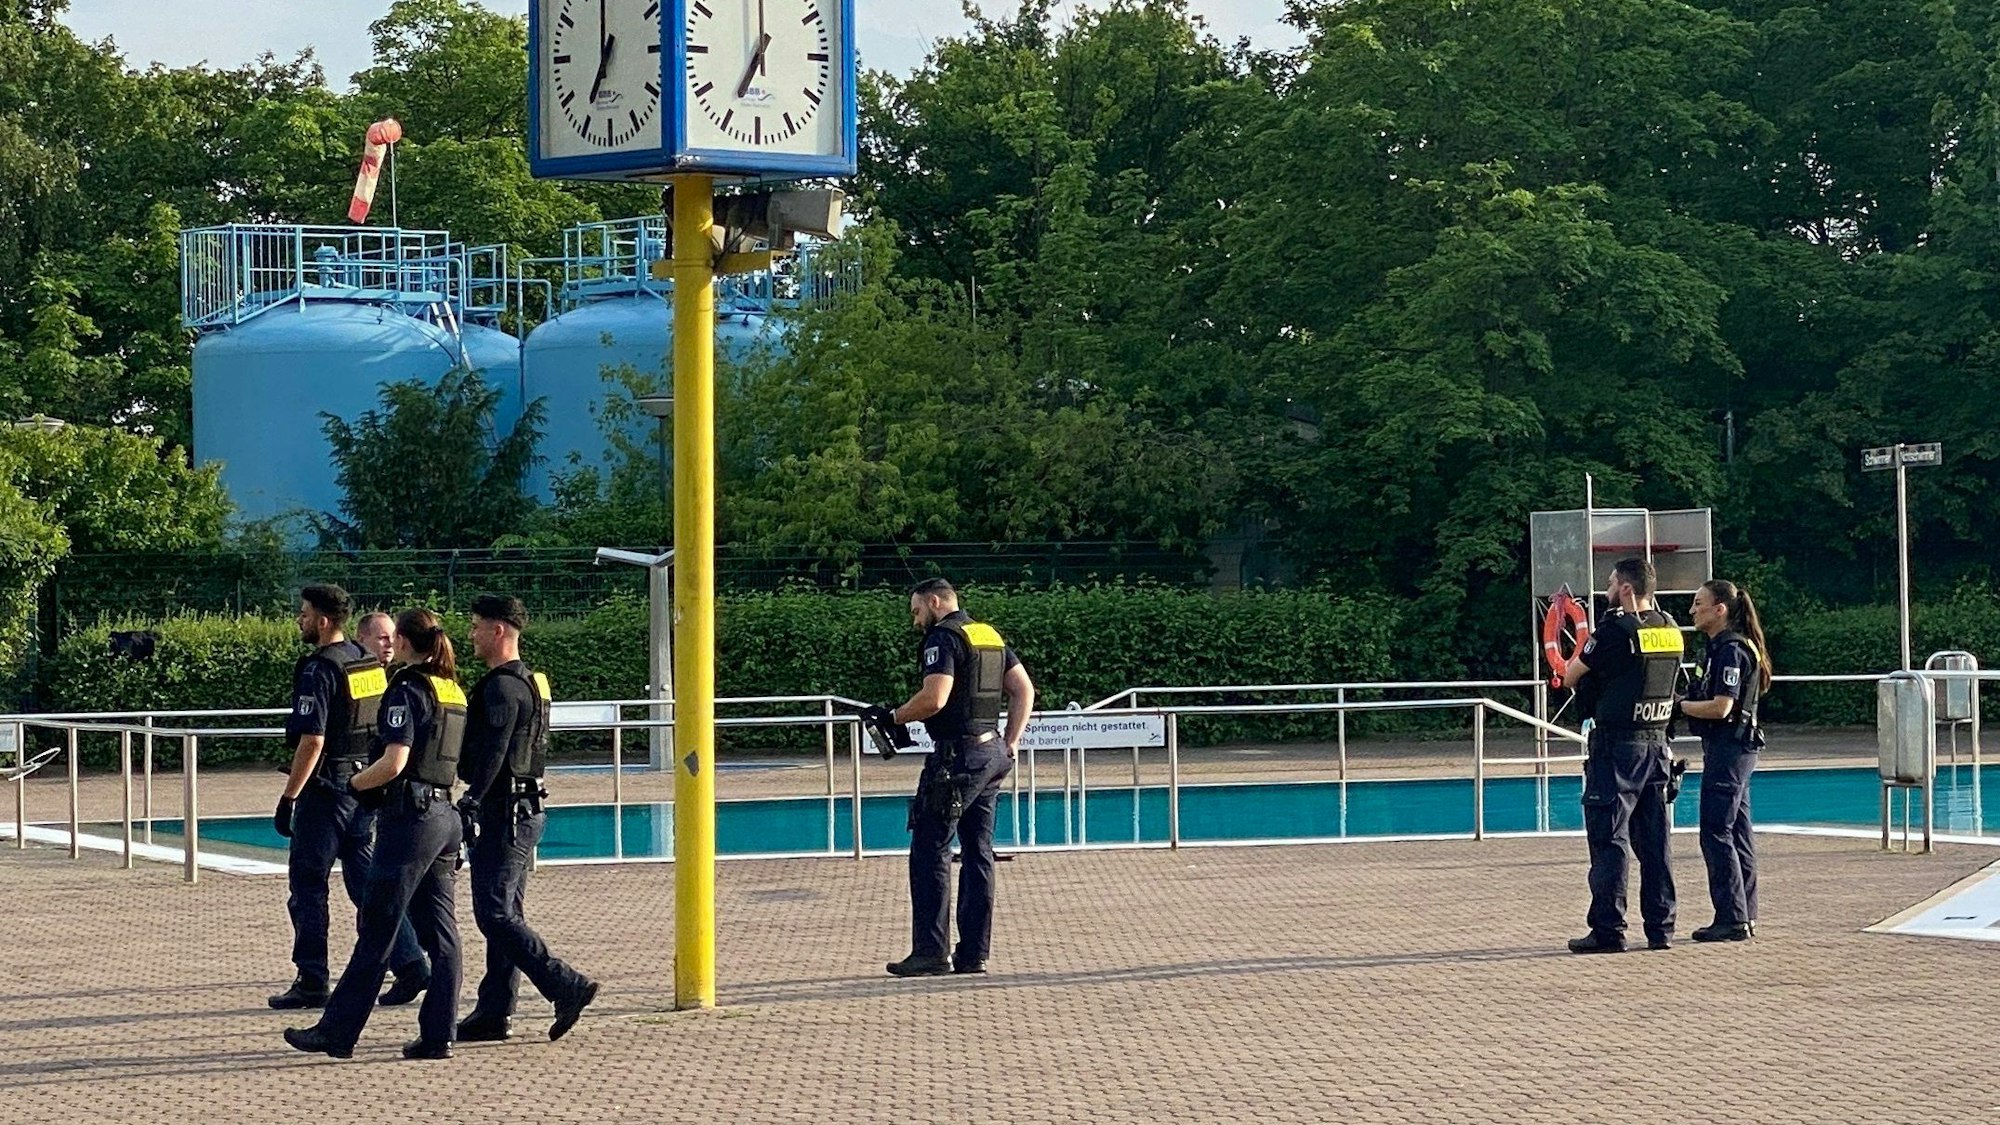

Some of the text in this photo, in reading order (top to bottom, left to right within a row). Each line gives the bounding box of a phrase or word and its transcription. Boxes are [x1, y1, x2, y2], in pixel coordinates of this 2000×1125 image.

[352, 672, 384, 695] POLIZE
[1633, 700, 1674, 721] POLIZE
[1024, 722, 1069, 734] Springen
[1072, 722, 1098, 731] nicht
[1101, 720, 1149, 732] gestattet.
[1038, 735, 1074, 746] barrier!
